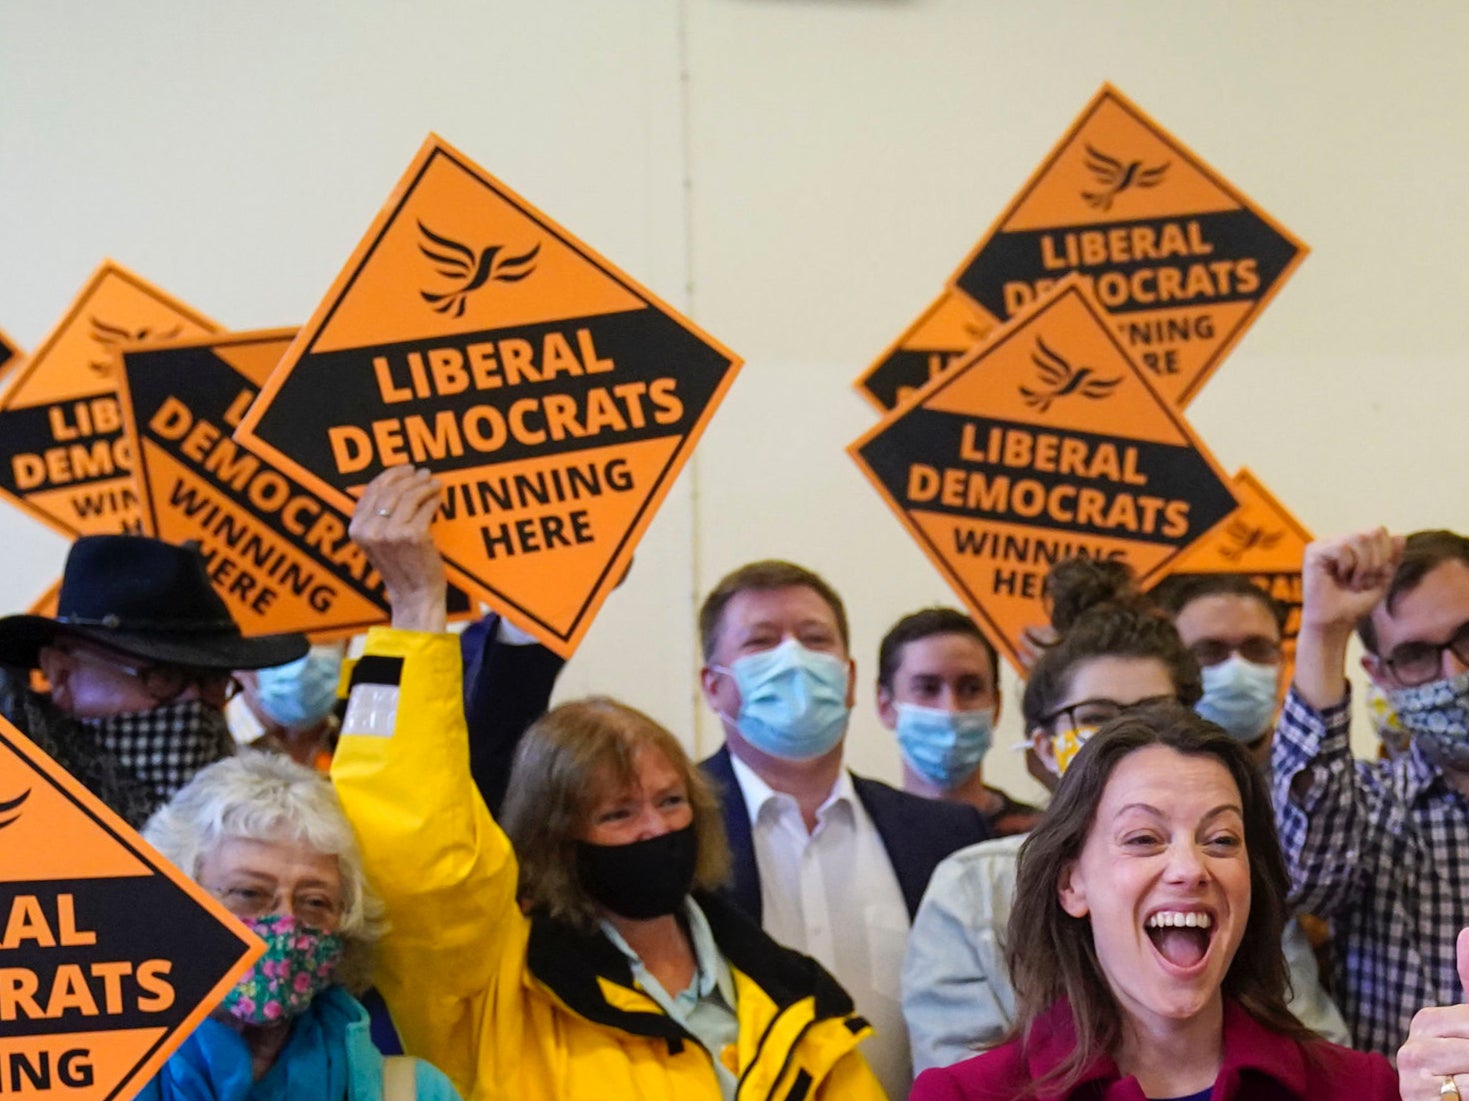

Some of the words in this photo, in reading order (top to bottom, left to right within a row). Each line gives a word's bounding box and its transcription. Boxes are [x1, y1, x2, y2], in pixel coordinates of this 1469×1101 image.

[1041, 220, 1213, 270] LIBERAL
[1003, 258, 1260, 316] DOCRATS
[372, 328, 614, 403] LIBERAL
[328, 378, 684, 474] DEMOCRATS
[960, 423, 1147, 486] LIBERAL
[481, 511, 594, 559] HERE
[907, 463, 1190, 538] DEMOCRATS
[169, 479, 336, 613] WINNING
